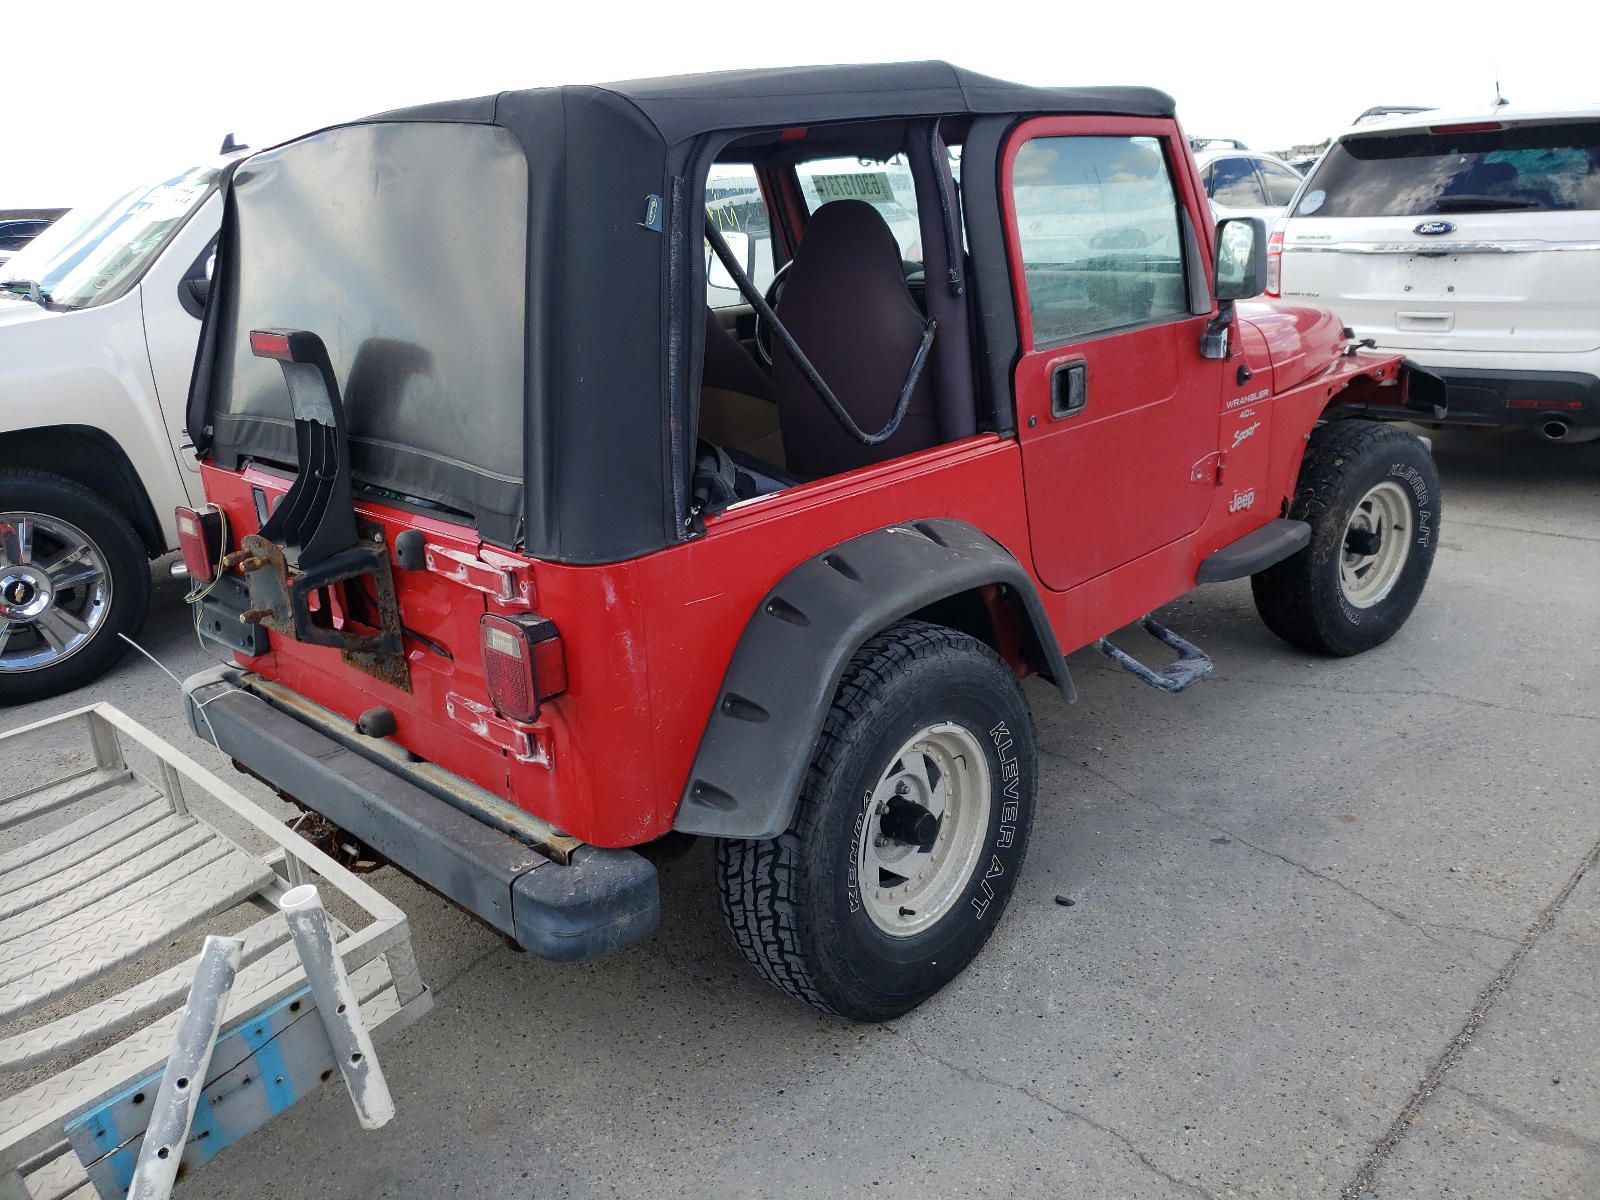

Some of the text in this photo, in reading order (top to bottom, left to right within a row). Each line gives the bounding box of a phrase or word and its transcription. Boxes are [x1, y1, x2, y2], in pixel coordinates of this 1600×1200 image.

[1420, 222, 1446, 233] Ford
[1226, 389, 1269, 409] WRANGLER
[1232, 421, 1261, 448] Sport
[1228, 489, 1255, 513] Jeep
[1387, 463, 1431, 548] KLEVER A/T
[970, 720, 1019, 920] KLEVER A/T
